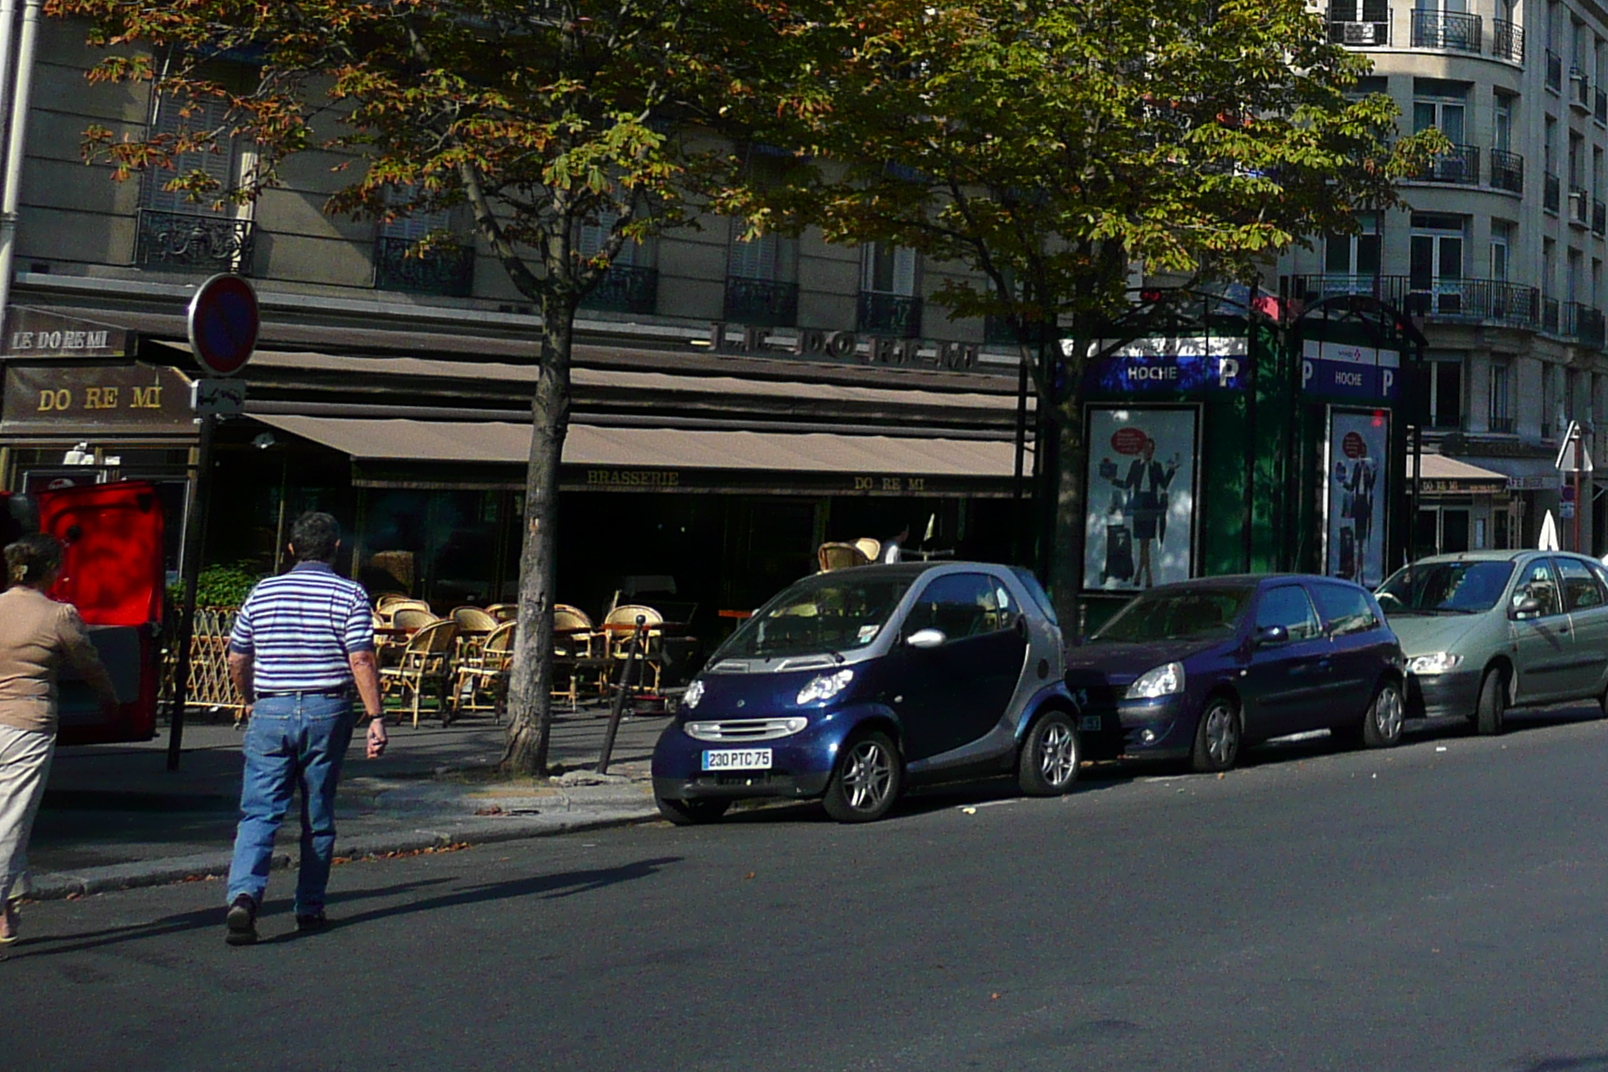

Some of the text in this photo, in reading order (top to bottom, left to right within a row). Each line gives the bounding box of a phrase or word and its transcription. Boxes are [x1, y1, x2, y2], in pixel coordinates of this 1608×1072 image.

[12, 330, 110, 350] LE DO RE MI
[794, 329, 856, 359] DO
[1127, 358, 1240, 387] HOCHE P
[1301, 360, 1393, 397] P HOCHE P
[37, 386, 163, 412] DO RE MI
[586, 469, 680, 486] BRASSERIE
[854, 476, 925, 491] DO RE MI
[709, 751, 770, 767] 230 PTC 75
